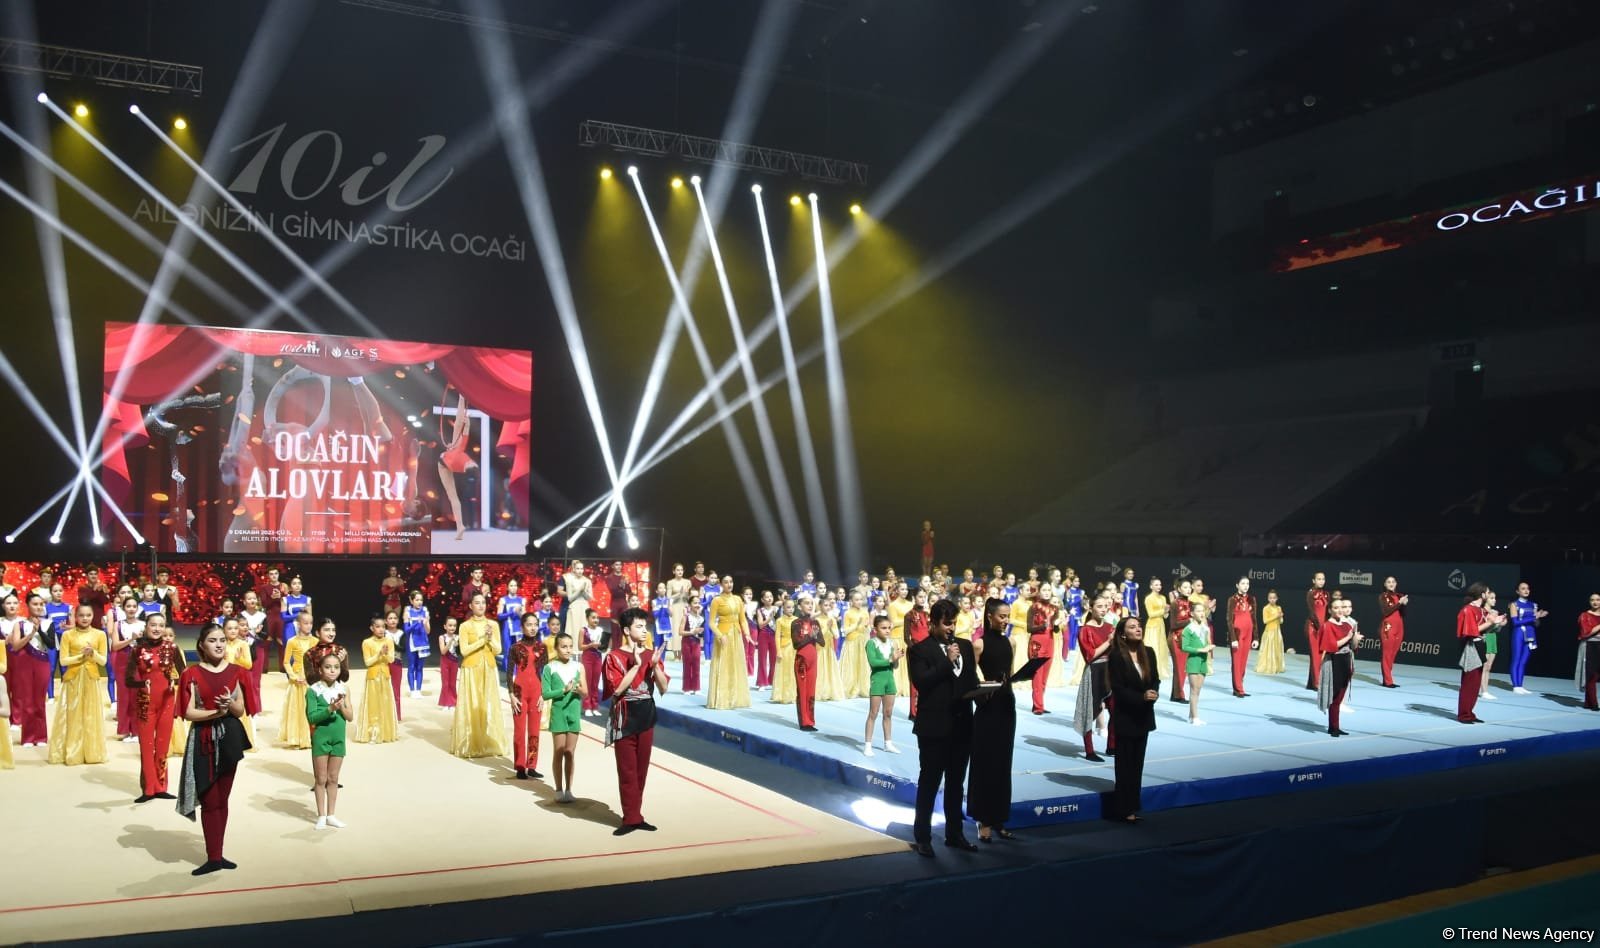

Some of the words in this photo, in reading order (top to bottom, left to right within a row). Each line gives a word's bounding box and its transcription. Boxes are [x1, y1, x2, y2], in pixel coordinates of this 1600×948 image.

[282, 210, 445, 252] GİMNASTİKA
[450, 233, 526, 261] OCAĞI
[275, 430, 381, 464] OCAĞIN
[244, 467, 408, 501] ALOVLARI
[873, 778, 896, 790] SPIETH
[1297, 772, 1322, 782] SPIETH
[1047, 803, 1079, 815] SPIETH
